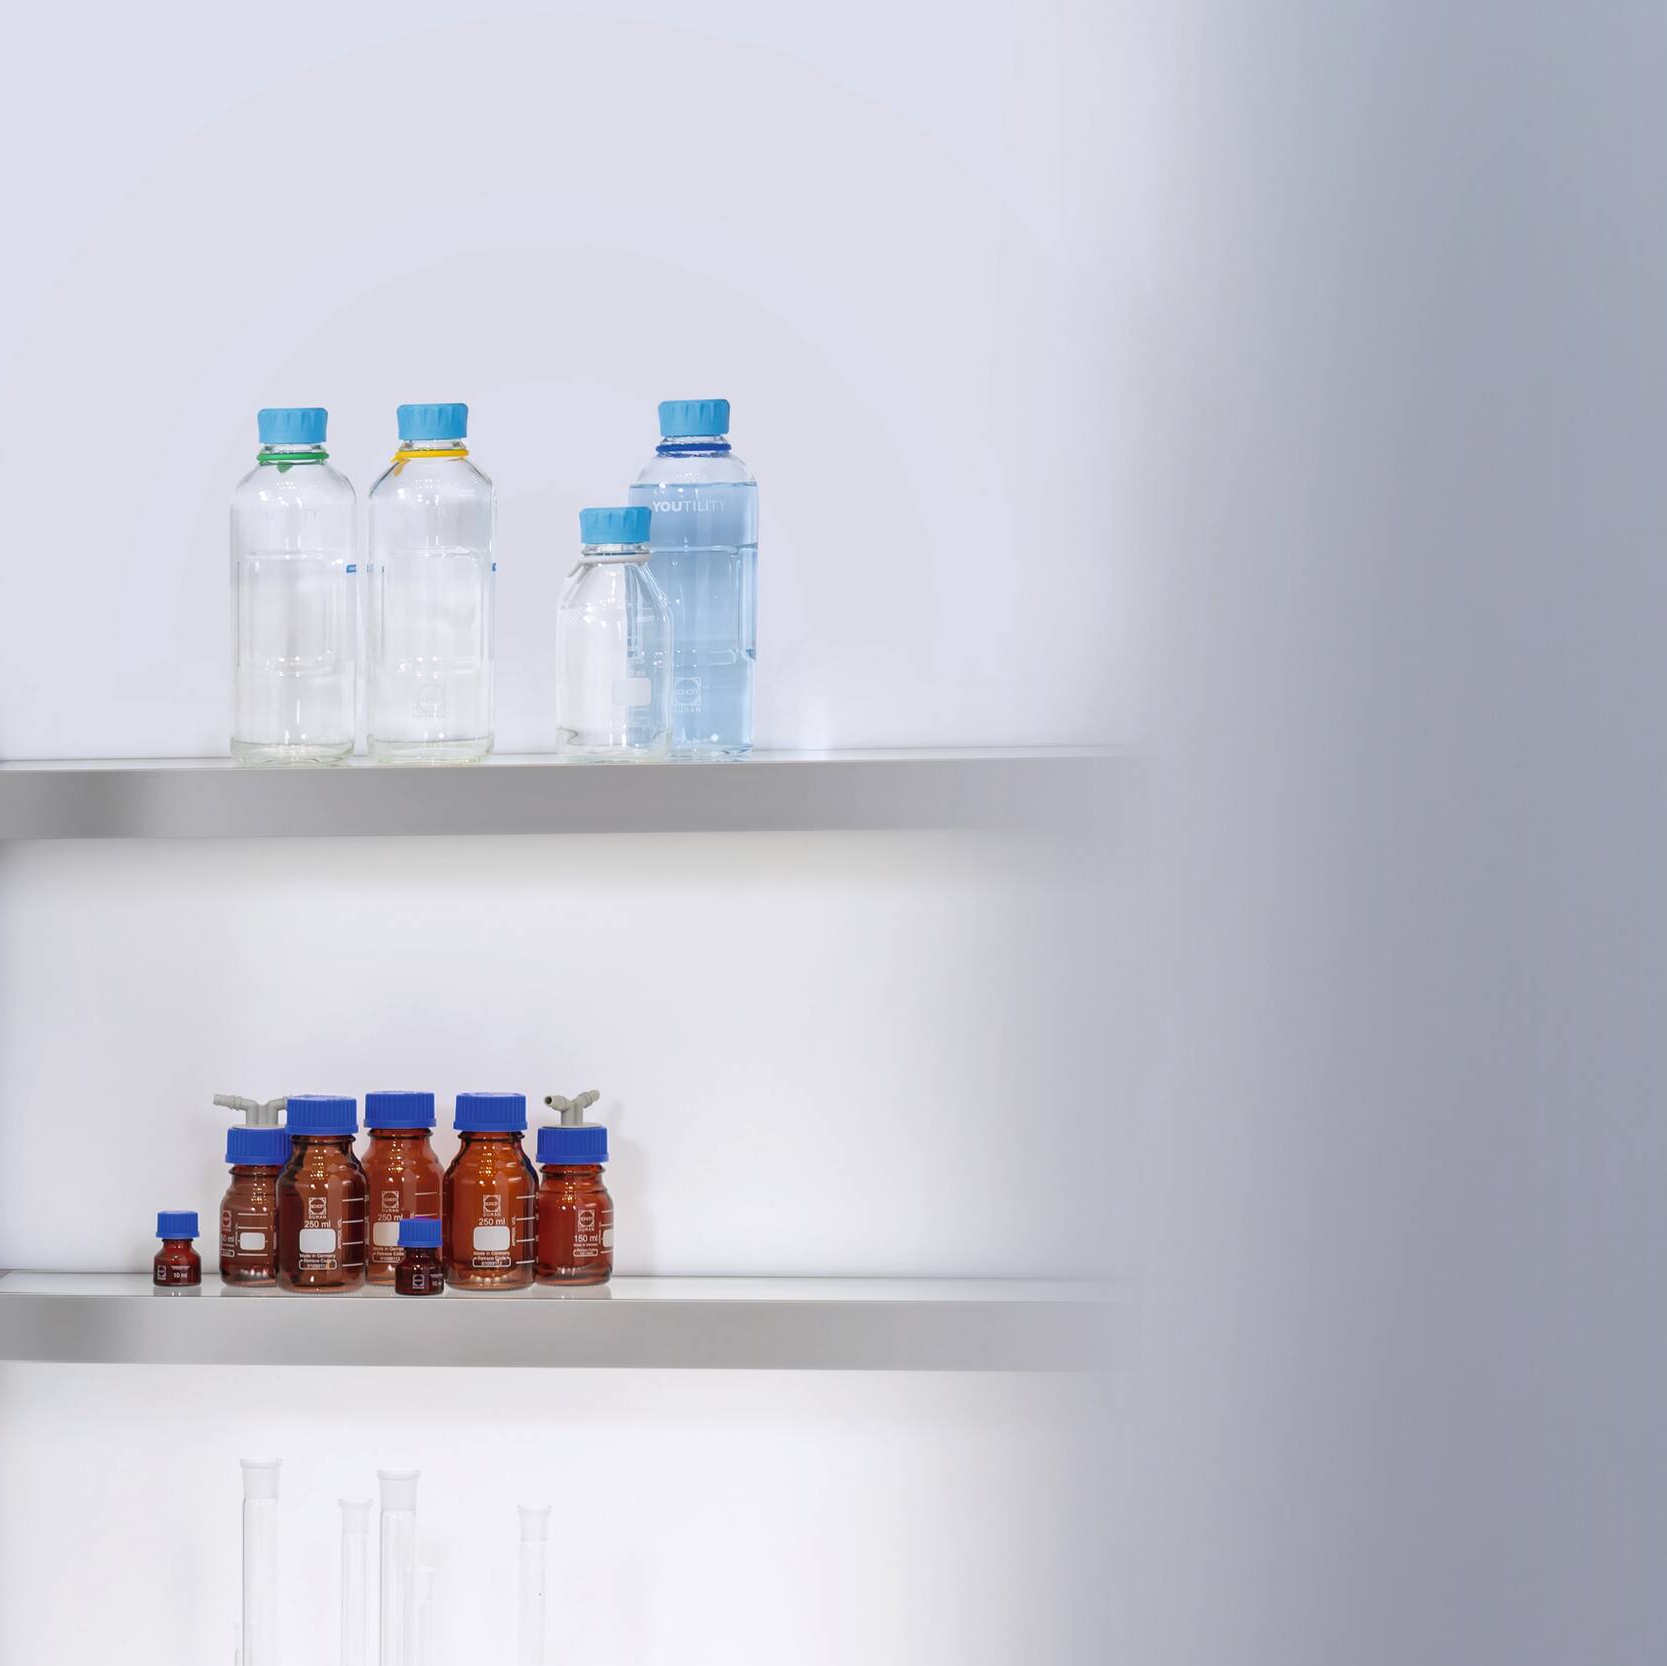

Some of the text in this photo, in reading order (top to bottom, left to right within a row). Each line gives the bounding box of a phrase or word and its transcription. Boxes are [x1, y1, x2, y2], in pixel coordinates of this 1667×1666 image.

[653, 501, 725, 512] YOUTILITY
[377, 1213, 404, 1222] 250 ml
[478, 1217, 506, 1226] 250 ml
[303, 1220, 331, 1229] 250 ml
[573, 1233, 598, 1243] 150 ml
